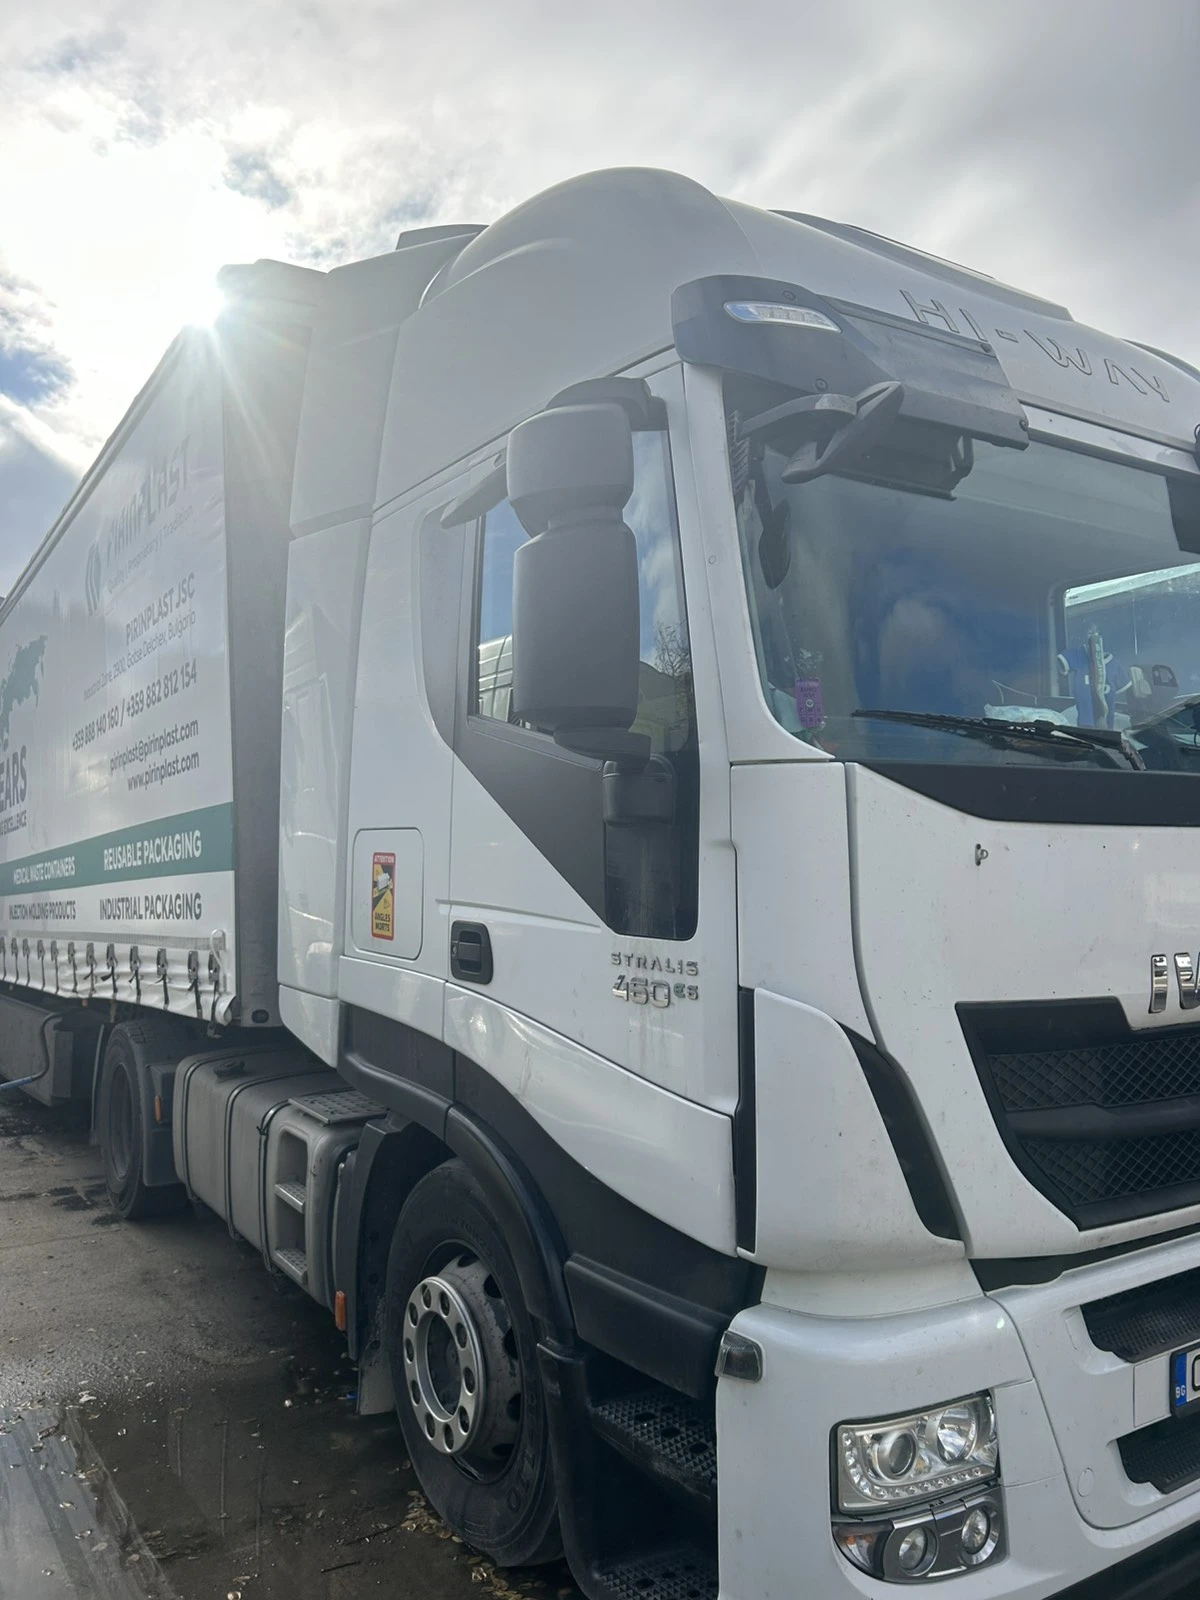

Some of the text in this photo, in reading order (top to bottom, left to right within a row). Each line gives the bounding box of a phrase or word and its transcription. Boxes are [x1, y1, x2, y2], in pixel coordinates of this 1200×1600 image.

[899, 289, 1170, 403] HI-WAY
[126, 572, 196, 646] PIRINPLAST JSC
[126, 689, 145, 717] +359
[146, 679, 162, 709] 882
[163, 669, 179, 699] 812
[180, 657, 197, 690] 154
[110, 719, 199, 776] pirinplast@pirinplast.com
[127, 751, 200, 791] www.pirinplast.com
[44, 856, 76, 880] CONTAINERS
[103, 841, 142, 871] REUSABLE
[143, 829, 202, 865] PACKAGING
[49, 900, 76, 920] PRODUCTS
[100, 897, 143, 920] INDUSTRIAL
[144, 892, 202, 920] PACKAGING
[374, 912, 390, 922] ANGLES
[375, 922, 390, 932] MORTS
[611, 951, 698, 976] STRALIS
[1175, 1385, 1186, 1398] BG
